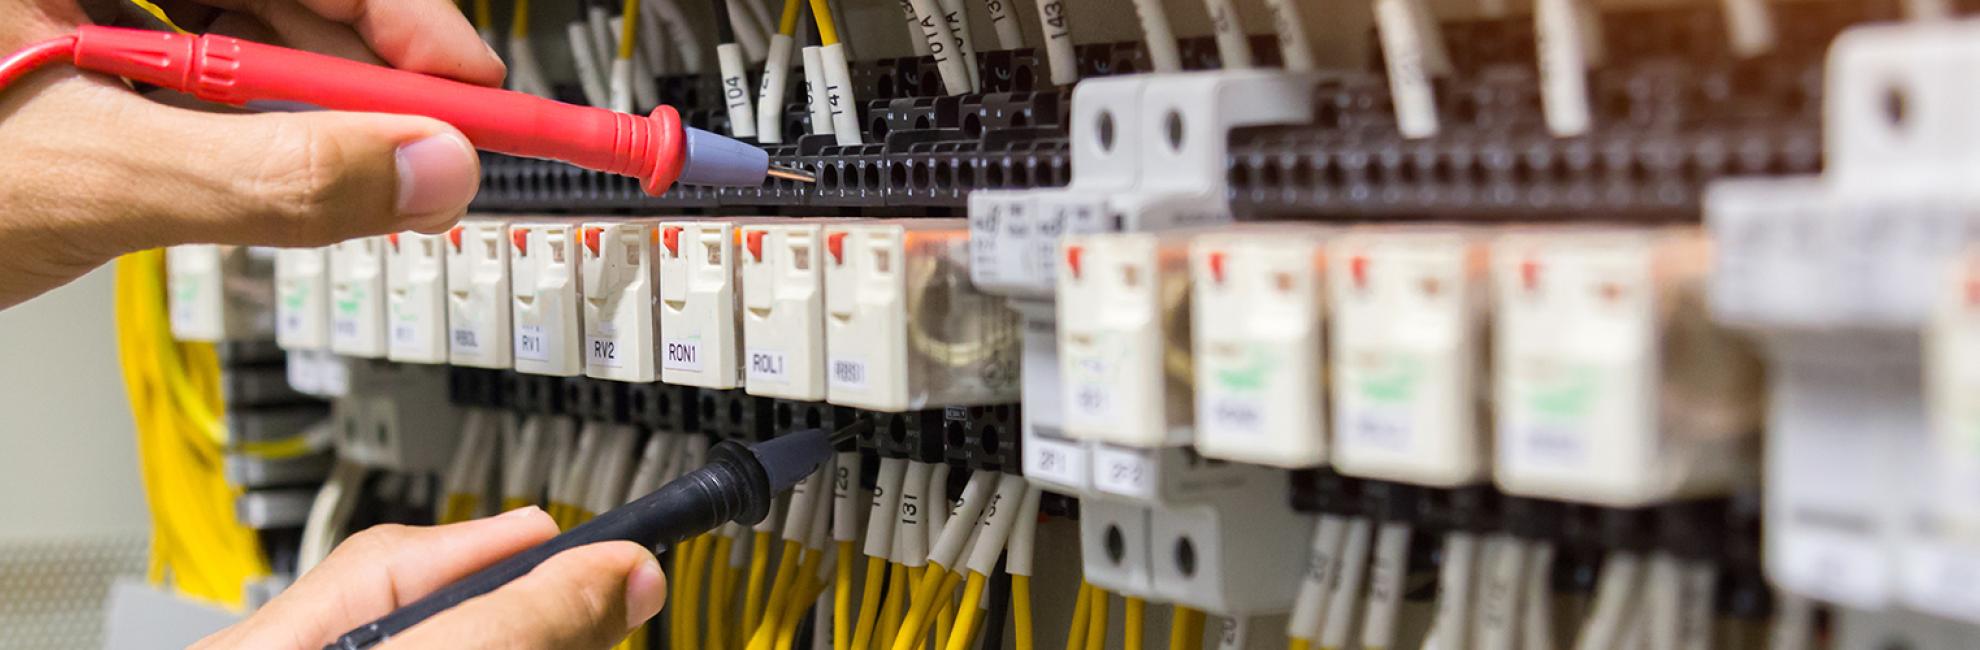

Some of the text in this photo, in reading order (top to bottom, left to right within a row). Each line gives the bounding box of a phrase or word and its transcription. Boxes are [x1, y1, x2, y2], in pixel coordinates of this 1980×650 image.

[1044, 1, 1068, 39] 143
[920, 15, 947, 62] 101A
[725, 76, 745, 108] 104
[827, 86, 842, 115] 141
[522, 335, 540, 353] RV1
[594, 340, 615, 359] RV2
[668, 343, 696, 362] RON1
[753, 354, 783, 374] ROL1
[902, 494, 918, 525] 131
